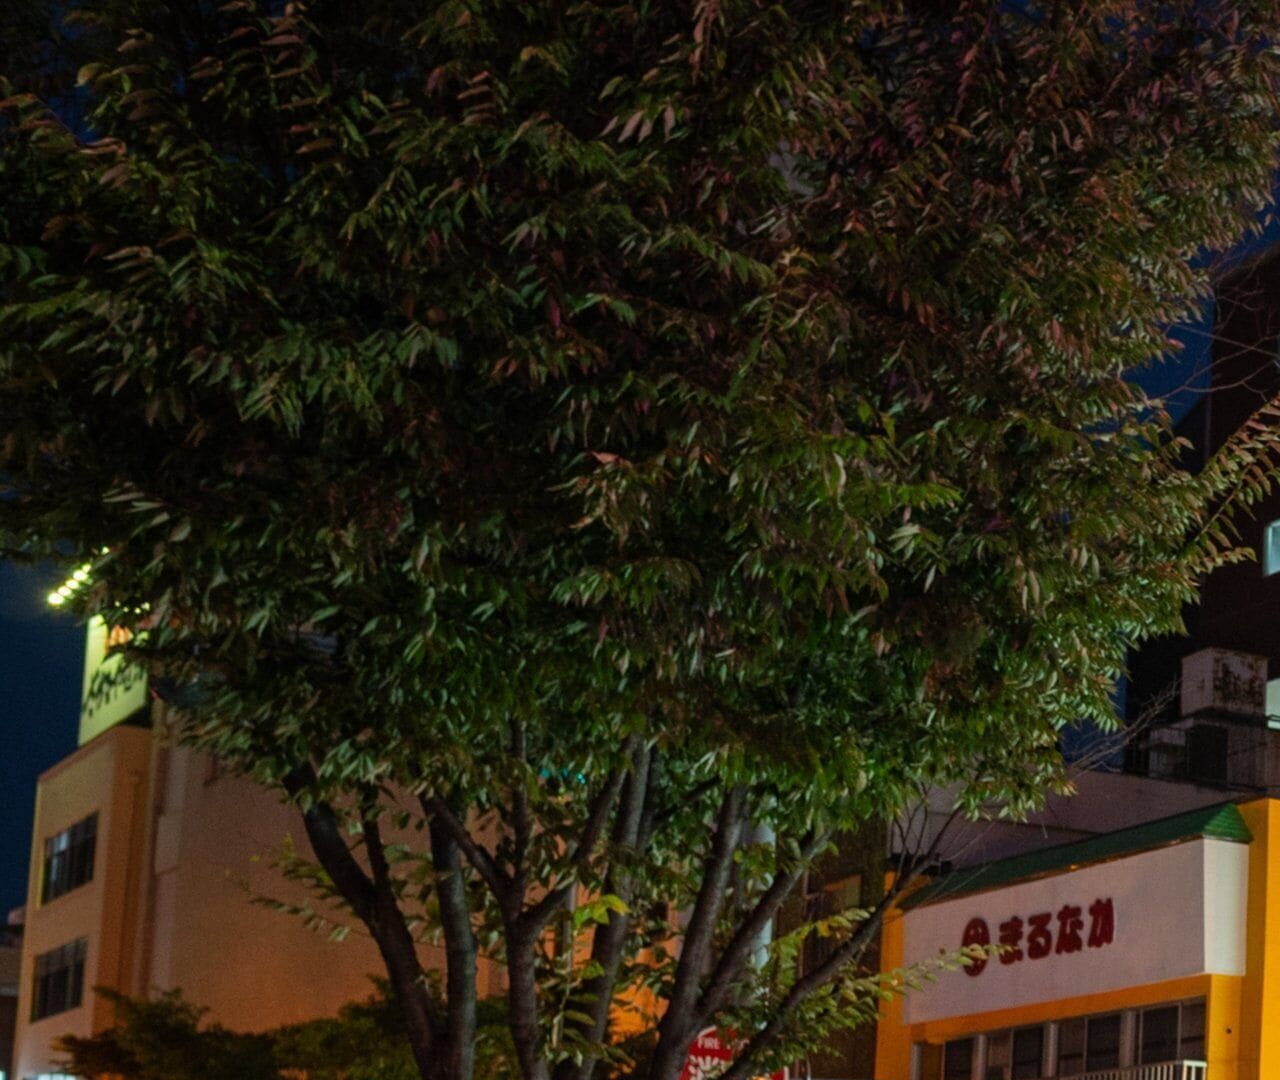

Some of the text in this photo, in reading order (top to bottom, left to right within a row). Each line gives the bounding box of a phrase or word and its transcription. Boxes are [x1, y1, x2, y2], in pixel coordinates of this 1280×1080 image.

[999, 898, 1114, 966] まるなか
[697, 1037, 720, 1050] FIRE
